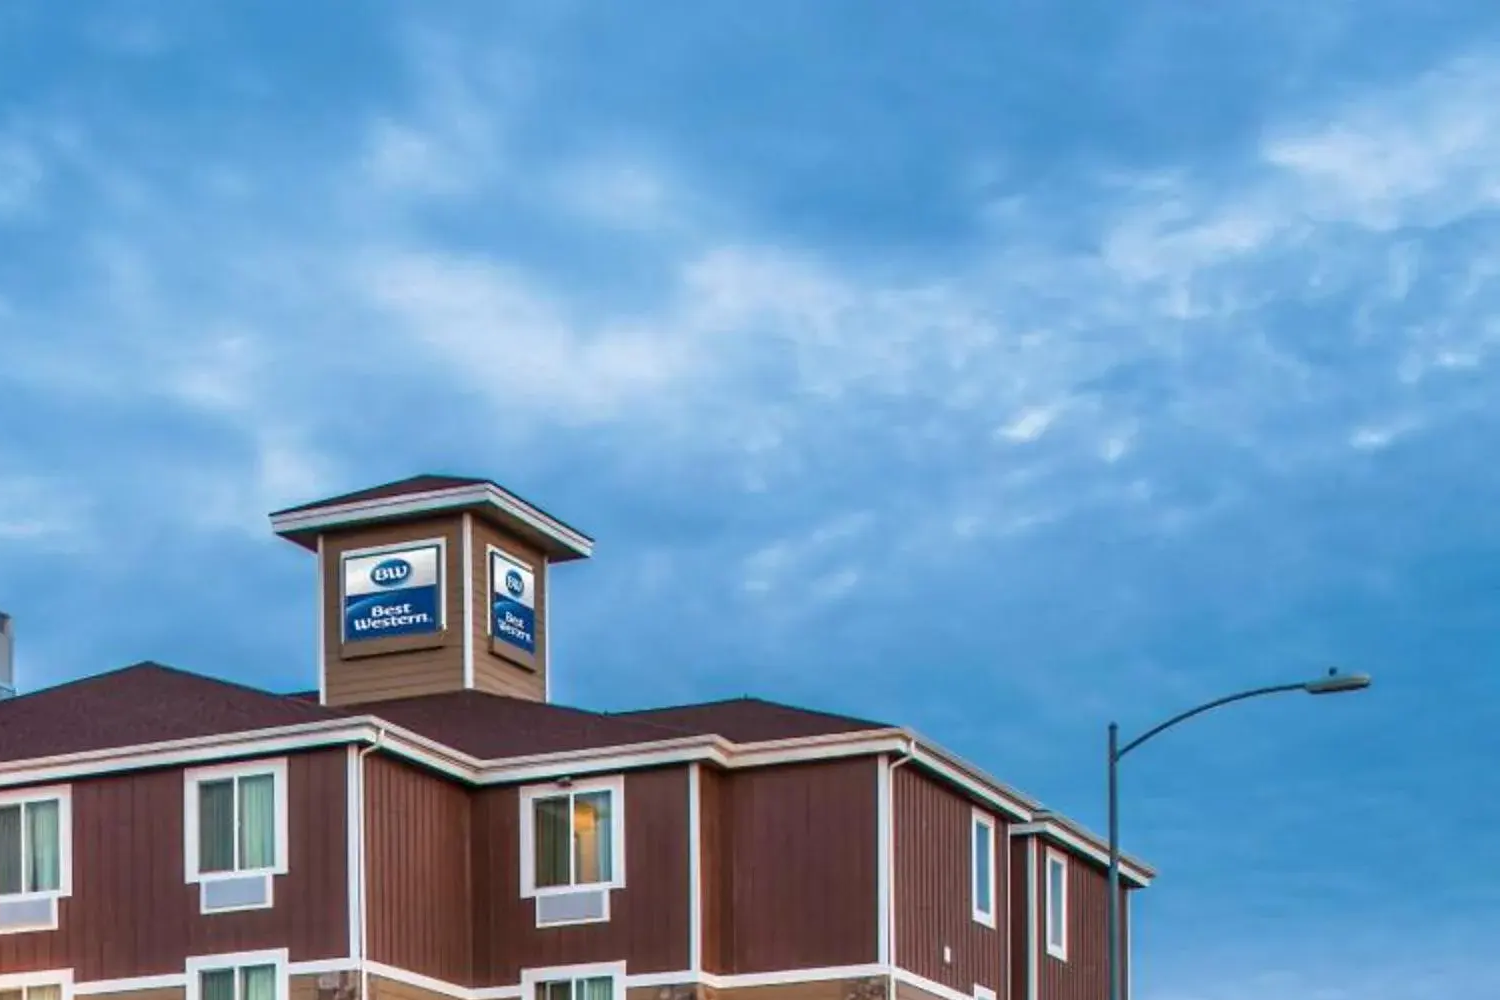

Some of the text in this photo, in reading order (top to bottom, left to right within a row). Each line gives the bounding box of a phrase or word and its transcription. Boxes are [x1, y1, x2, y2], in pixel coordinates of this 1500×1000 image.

[374, 563, 408, 582] BW
[370, 602, 412, 618] Best
[353, 613, 429, 631] Western
